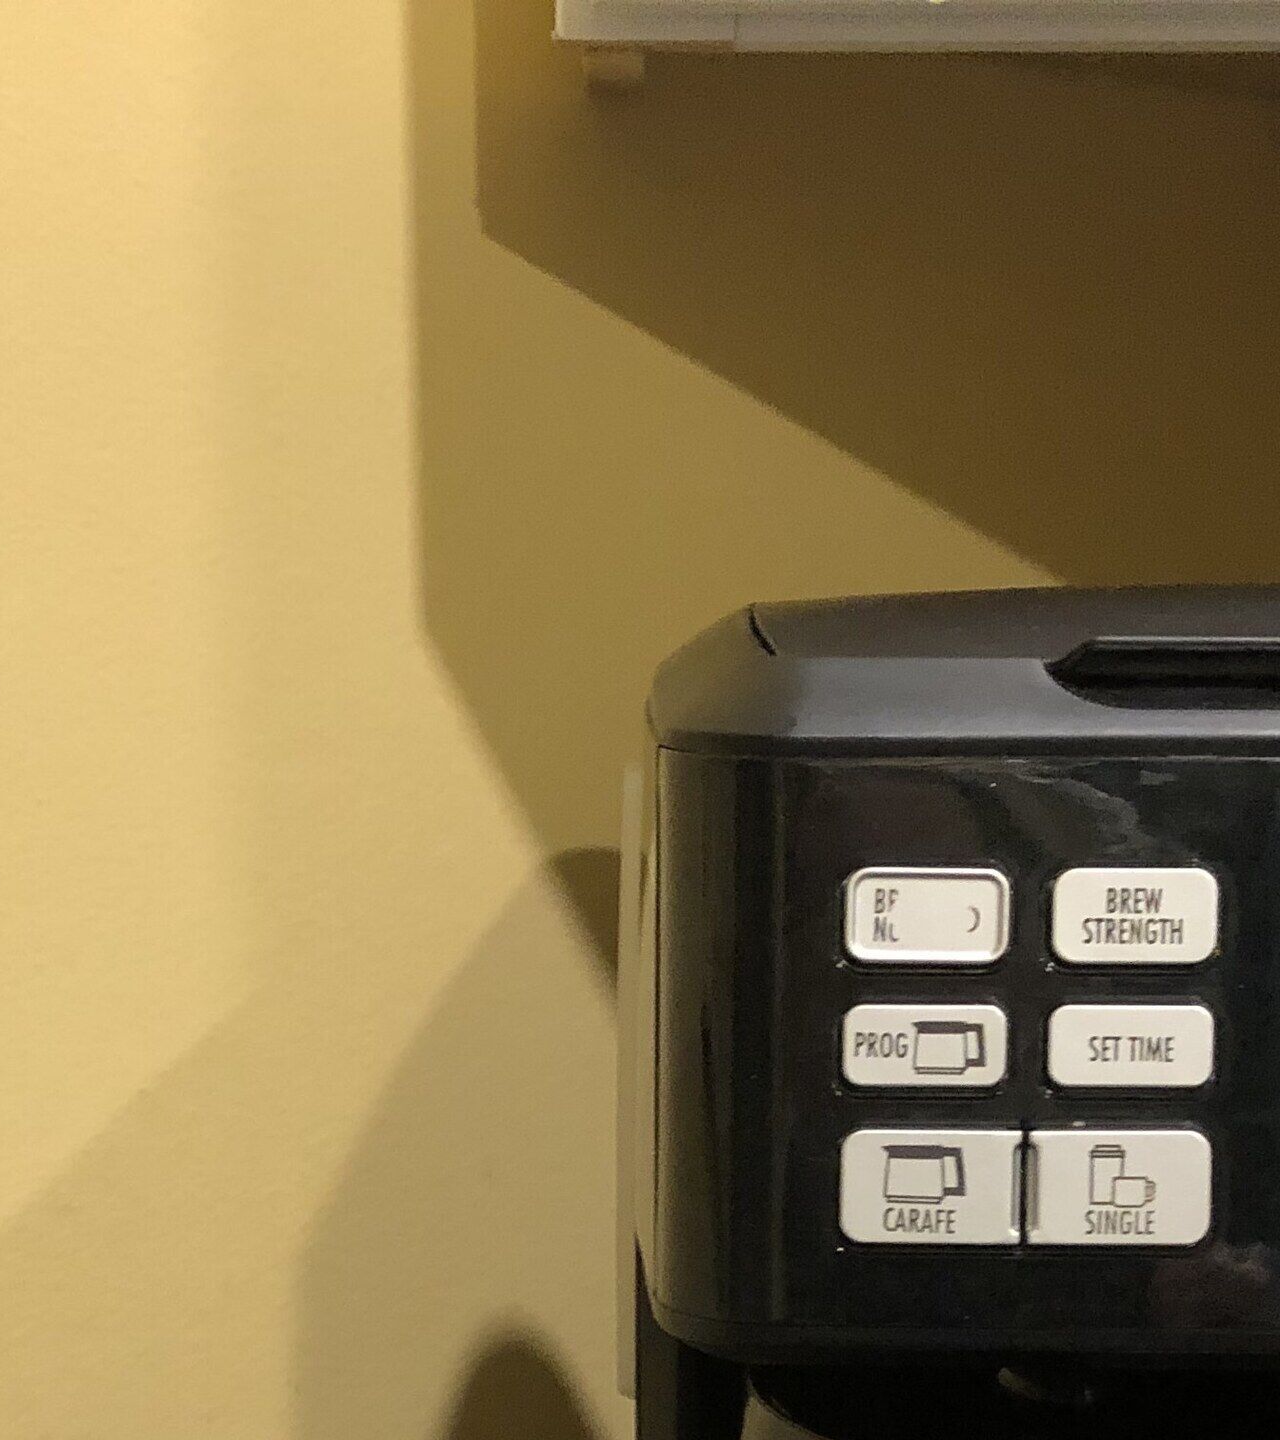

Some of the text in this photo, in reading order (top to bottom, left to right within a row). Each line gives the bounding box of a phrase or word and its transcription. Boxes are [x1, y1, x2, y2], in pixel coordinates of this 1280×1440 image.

[1105, 887, 1163, 915] BREW
[1082, 917, 1184, 946] STRENGTH
[853, 1033, 909, 1059] PROG
[1088, 1035, 1175, 1063] SET TIME
[882, 1206, 957, 1234] CARAFE
[1084, 1208, 1156, 1236] SINGLE
